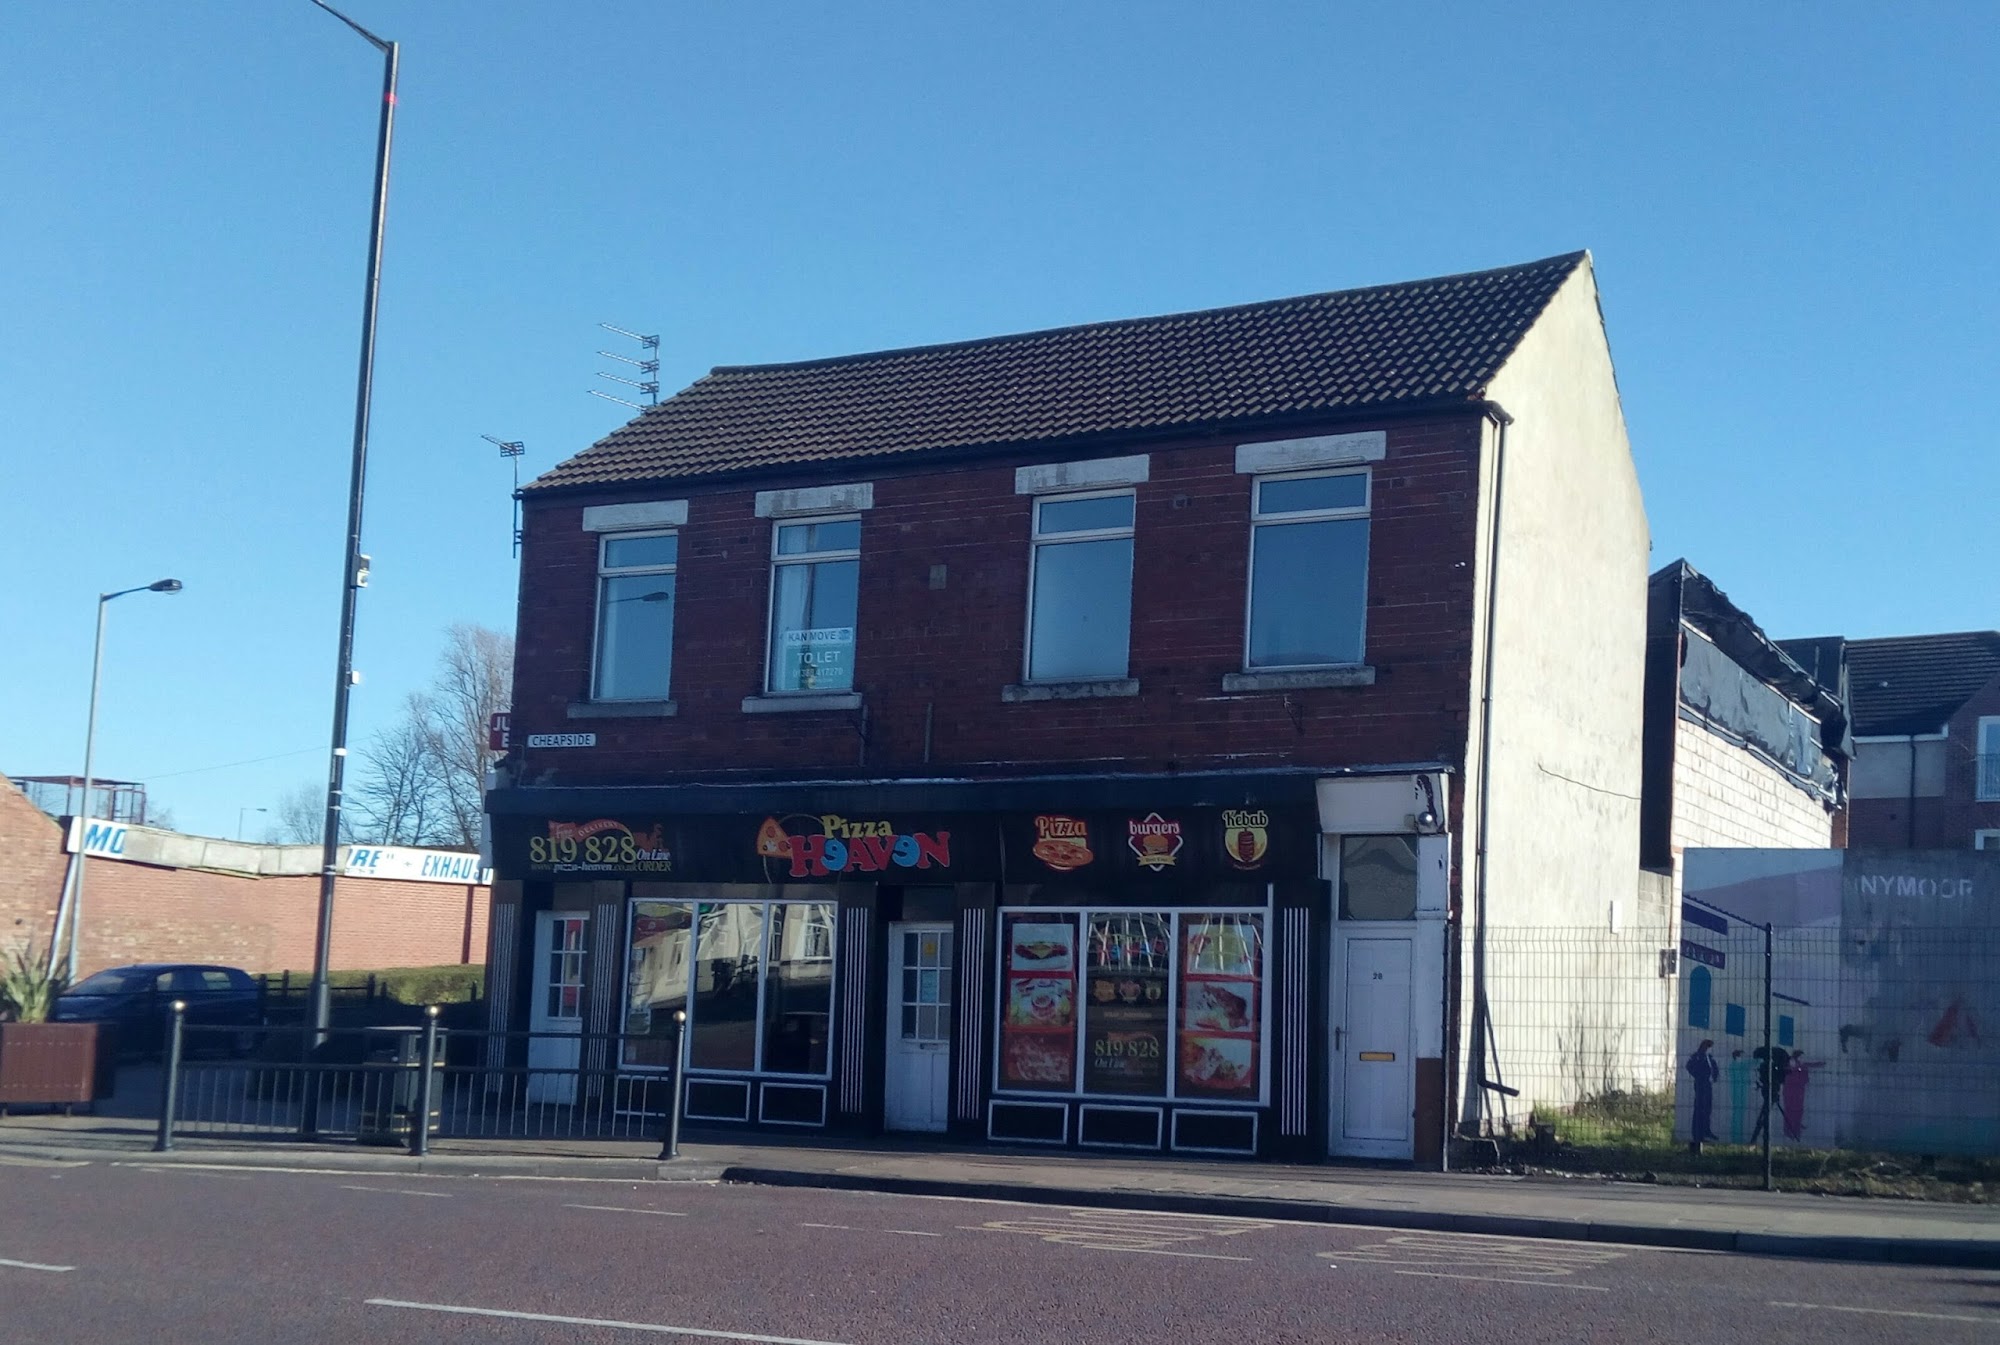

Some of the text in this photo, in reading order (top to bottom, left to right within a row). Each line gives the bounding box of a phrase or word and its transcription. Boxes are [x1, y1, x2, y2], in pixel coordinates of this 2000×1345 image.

[797, 651, 841, 664] TO LET
[532, 734, 591, 746] CHEAPSIDE
[821, 814, 893, 839] Pizza
[1035, 816, 1088, 837] Pizza
[1129, 820, 1180, 836] burgers
[1222, 810, 1269, 828] Kebab
[578, 820, 618, 837] DELIVERY
[84, 824, 127, 854] MO
[529, 836, 638, 863] 819 828
[638, 861, 672, 872] ORDER
[1094, 1039, 1160, 1058] 819 828
